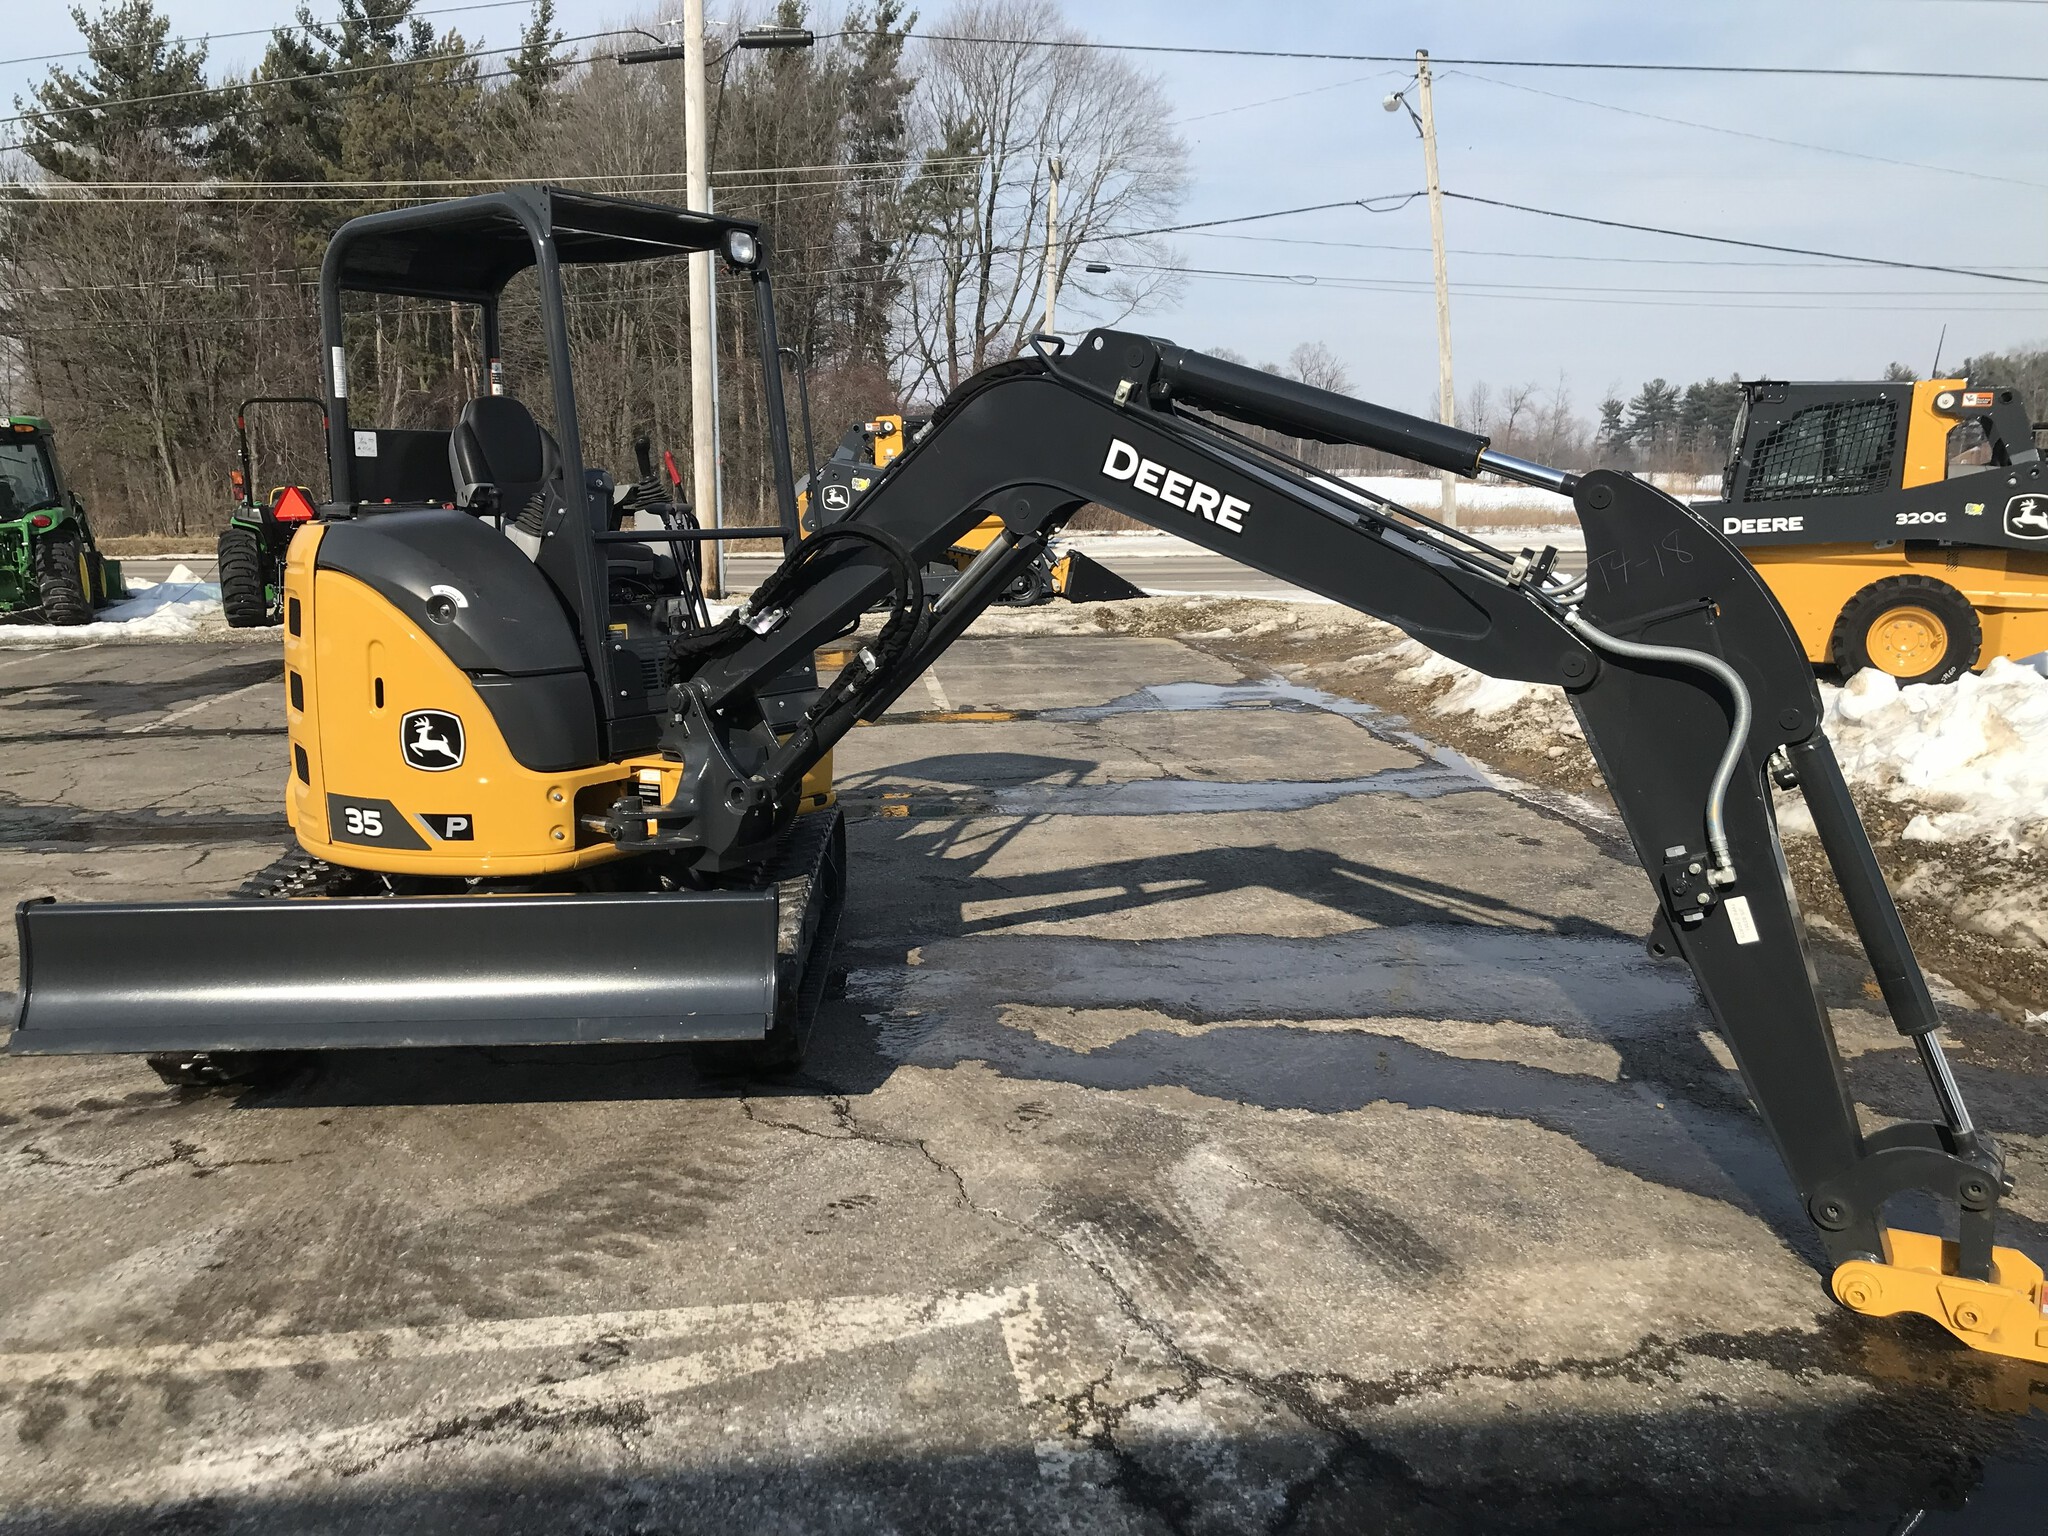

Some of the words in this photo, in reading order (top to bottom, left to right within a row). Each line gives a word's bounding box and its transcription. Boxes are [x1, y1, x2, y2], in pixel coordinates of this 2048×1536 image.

[1102, 438, 1251, 534] DEERE
[1723, 516, 1804, 534] DEERE
[1895, 512, 1947, 525] 320G
[344, 807, 384, 837] 35
[445, 816, 468, 838] P
